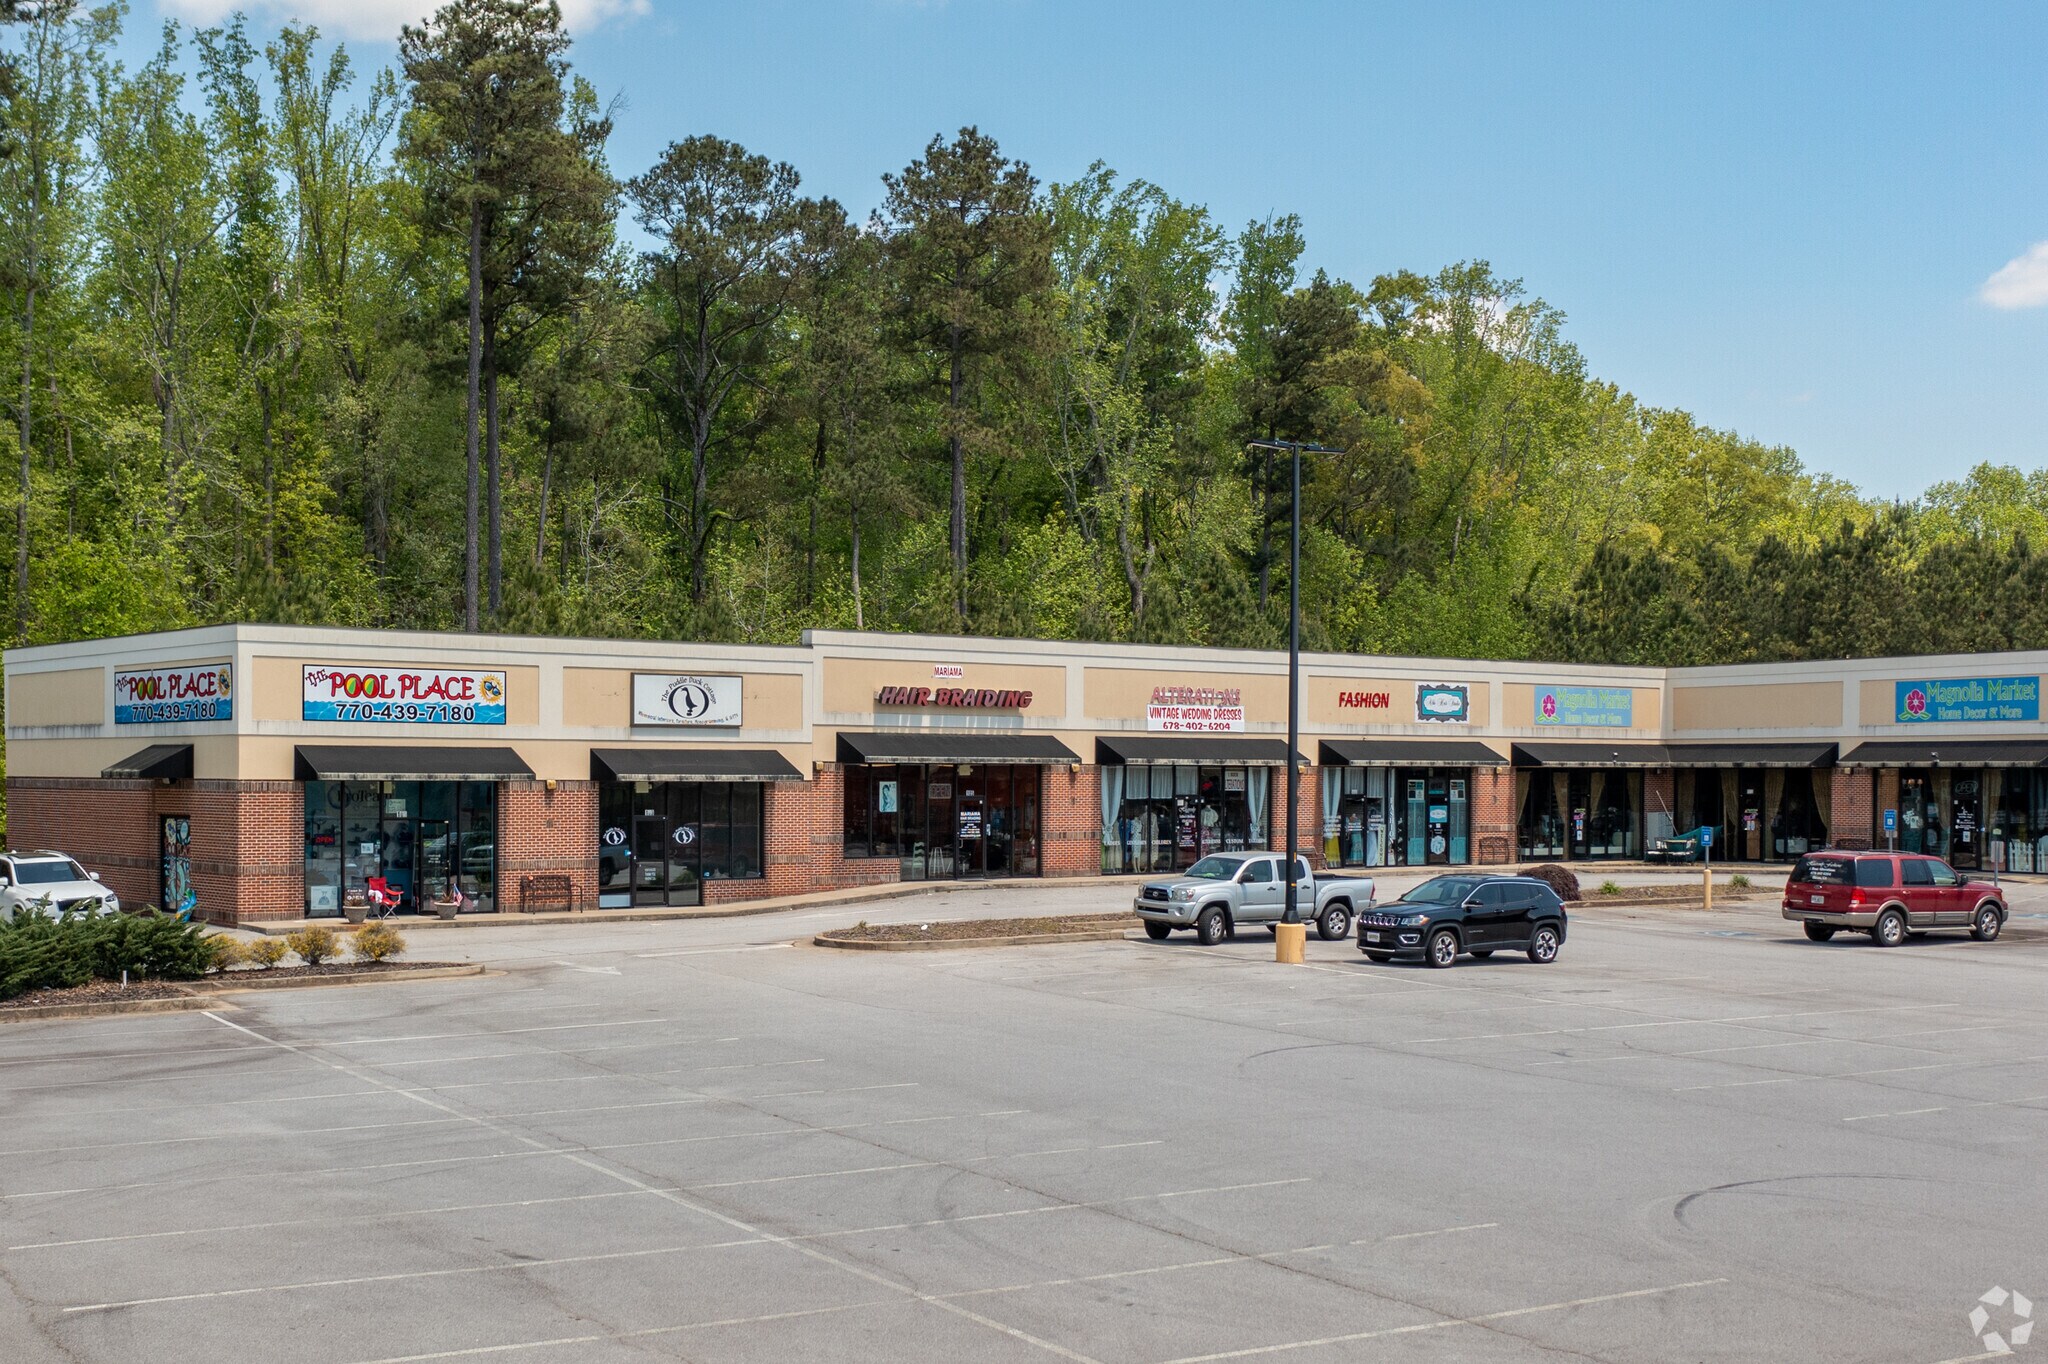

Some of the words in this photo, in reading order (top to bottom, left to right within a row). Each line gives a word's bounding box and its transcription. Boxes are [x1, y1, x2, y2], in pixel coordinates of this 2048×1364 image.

[933, 666, 963, 677] MARIAMA
[115, 675, 129, 692] THE
[128, 676, 166, 701] POOL
[168, 672, 217, 698] PLACE
[305, 669, 328, 687] THE
[328, 671, 395, 698] POOL
[399, 675, 475, 701] PLACE
[661, 689, 669, 702] The
[668, 677, 687, 690] Puddle
[689, 676, 702, 685] Duck
[703, 682, 717, 704] Cottage
[1925, 681, 1984, 706] Magnolia
[1987, 680, 2036, 701] Market
[880, 686, 931, 706] HAIR
[935, 687, 1033, 708] BRAIDING
[1338, 692, 1390, 708] FASHION
[1556, 688, 1597, 711] Magnolia
[1599, 690, 1631, 709] Market
[132, 702, 216, 720] 770-439-7180
[336, 703, 475, 721] 770-439-7180
[1149, 707, 1179, 719] VINTAGE
[1181, 708, 1212, 720] WEDDING
[1213, 708, 1242, 720] DRESSES
[1937, 706, 1962, 720] Home
[1963, 706, 1988, 719] Decor
[1989, 707, 1998, 719] &
[1999, 705, 2023, 719] More
[1162, 721, 1231, 730] 678-402-6204
[931, 785, 951, 796] OPEN
[1955, 782, 1978, 793] OPEN
